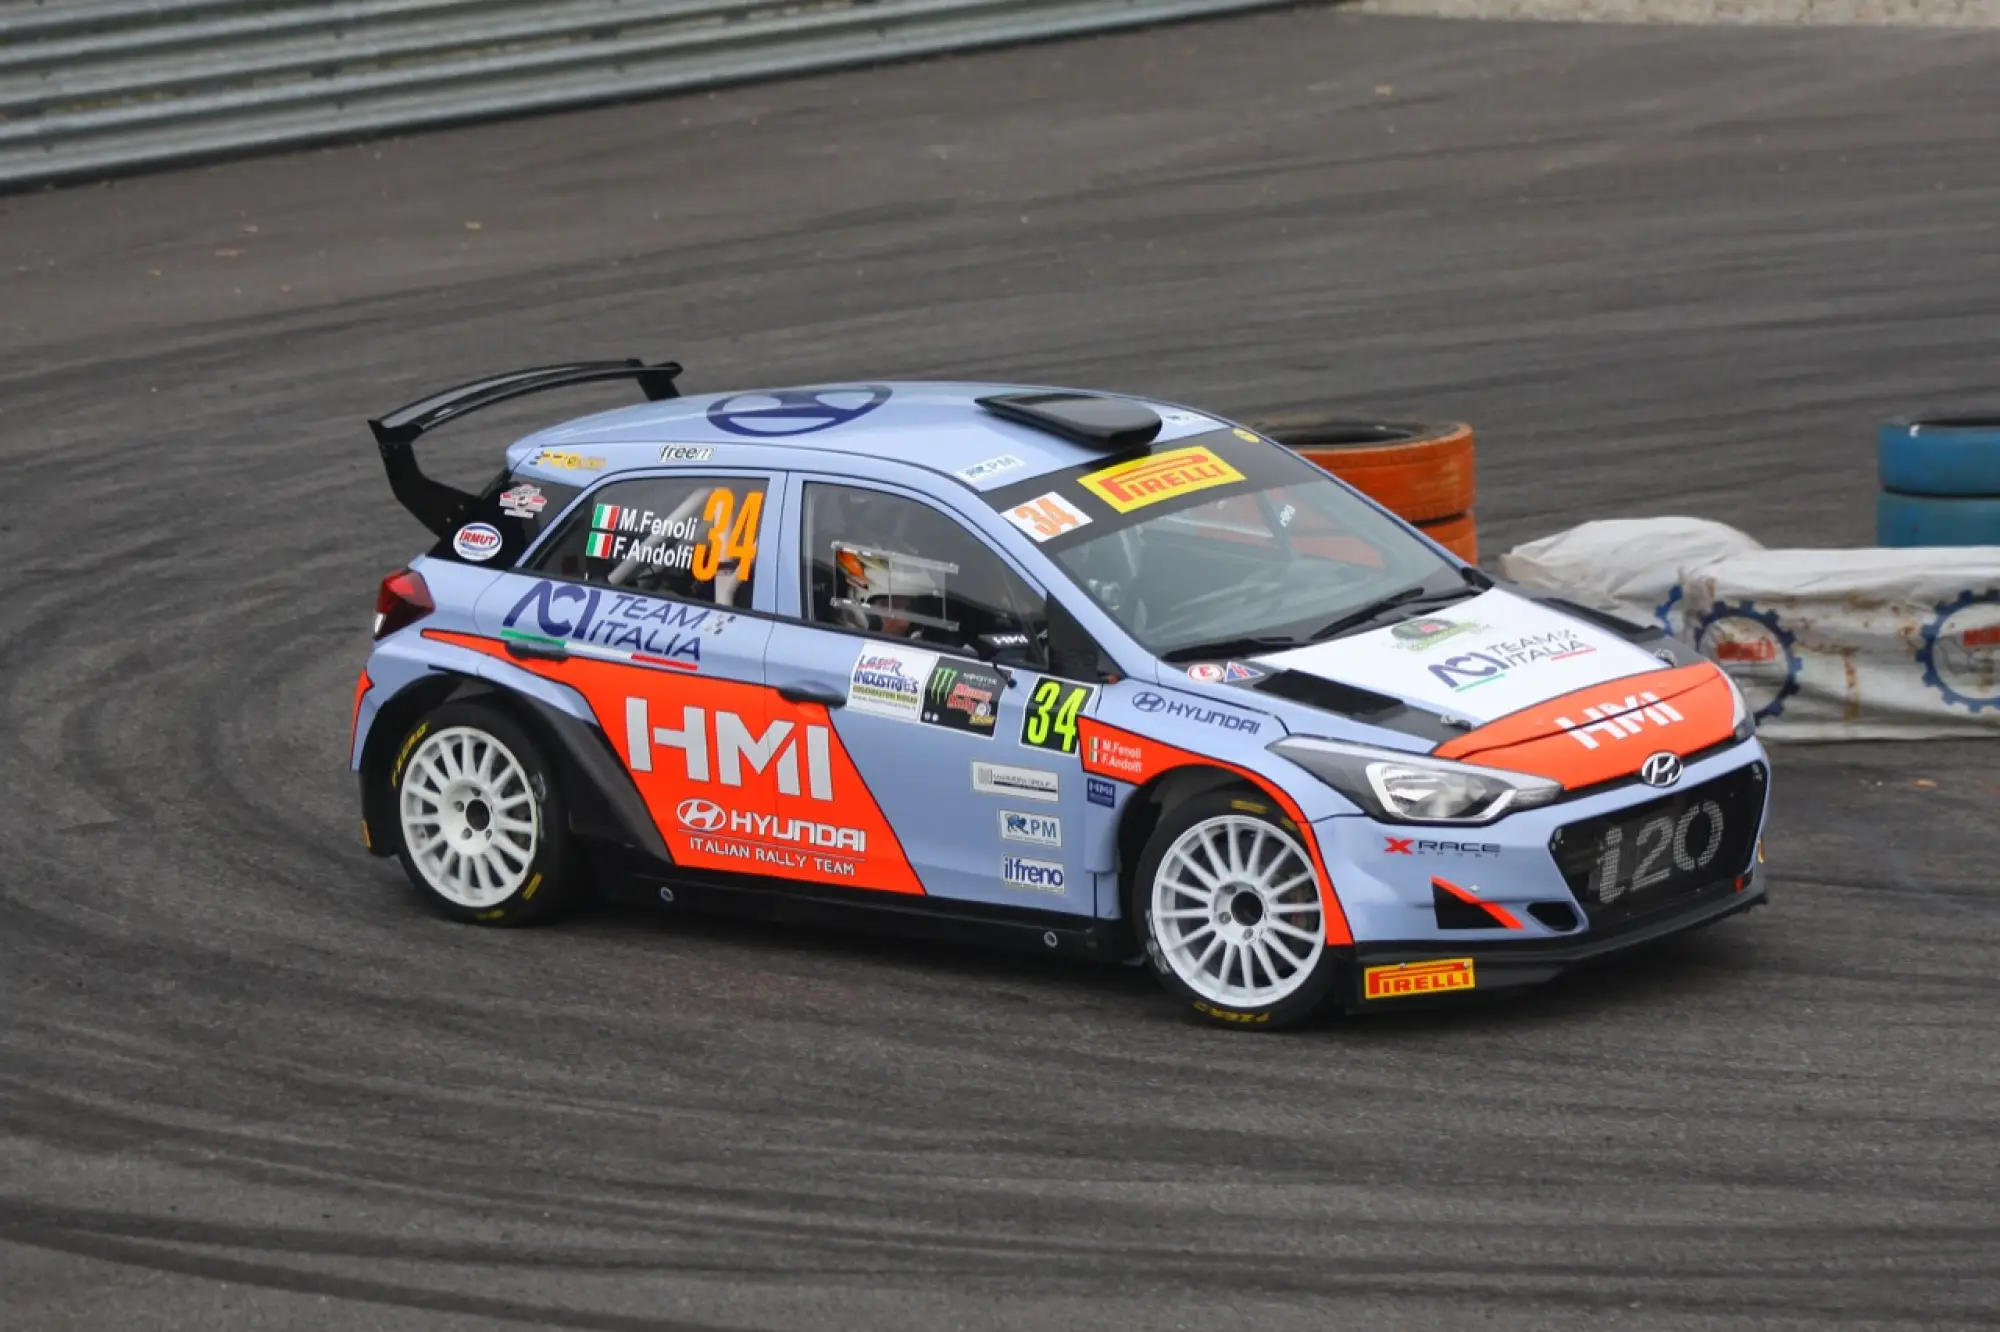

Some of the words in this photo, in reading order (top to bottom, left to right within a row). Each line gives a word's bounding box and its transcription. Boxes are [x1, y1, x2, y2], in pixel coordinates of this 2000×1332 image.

[1097, 454, 1227, 504] PIRELLI
[619, 506, 697, 541] M.Fenoli
[694, 488, 764, 582] 34
[1014, 497, 1079, 536] 34
[459, 529, 497, 546] IRMUT
[612, 536, 692, 569] F.Andolfi
[502, 580, 602, 640] ACI
[608, 593, 708, 629] TEAM
[590, 618, 701, 661] ITALIA
[1486, 631, 1557, 656] TEAM
[1505, 639, 1588, 668] ITALIA
[1427, 651, 1508, 689] ACI
[1028, 682, 1087, 753] 34
[1167, 701, 1262, 735] HYUNDAI
[1554, 691, 1685, 751] HMI
[625, 696, 835, 802] HMI
[731, 809, 867, 852] HYUNDAI
[1384, 836, 1414, 856] X
[1418, 840, 1501, 854] RACE
[689, 837, 751, 860] ITALIAN
[755, 847, 806, 868] RALLY
[814, 857, 856, 876] TEAM
[1596, 800, 1725, 904] i20
[1367, 961, 1471, 996] PIRELLI
